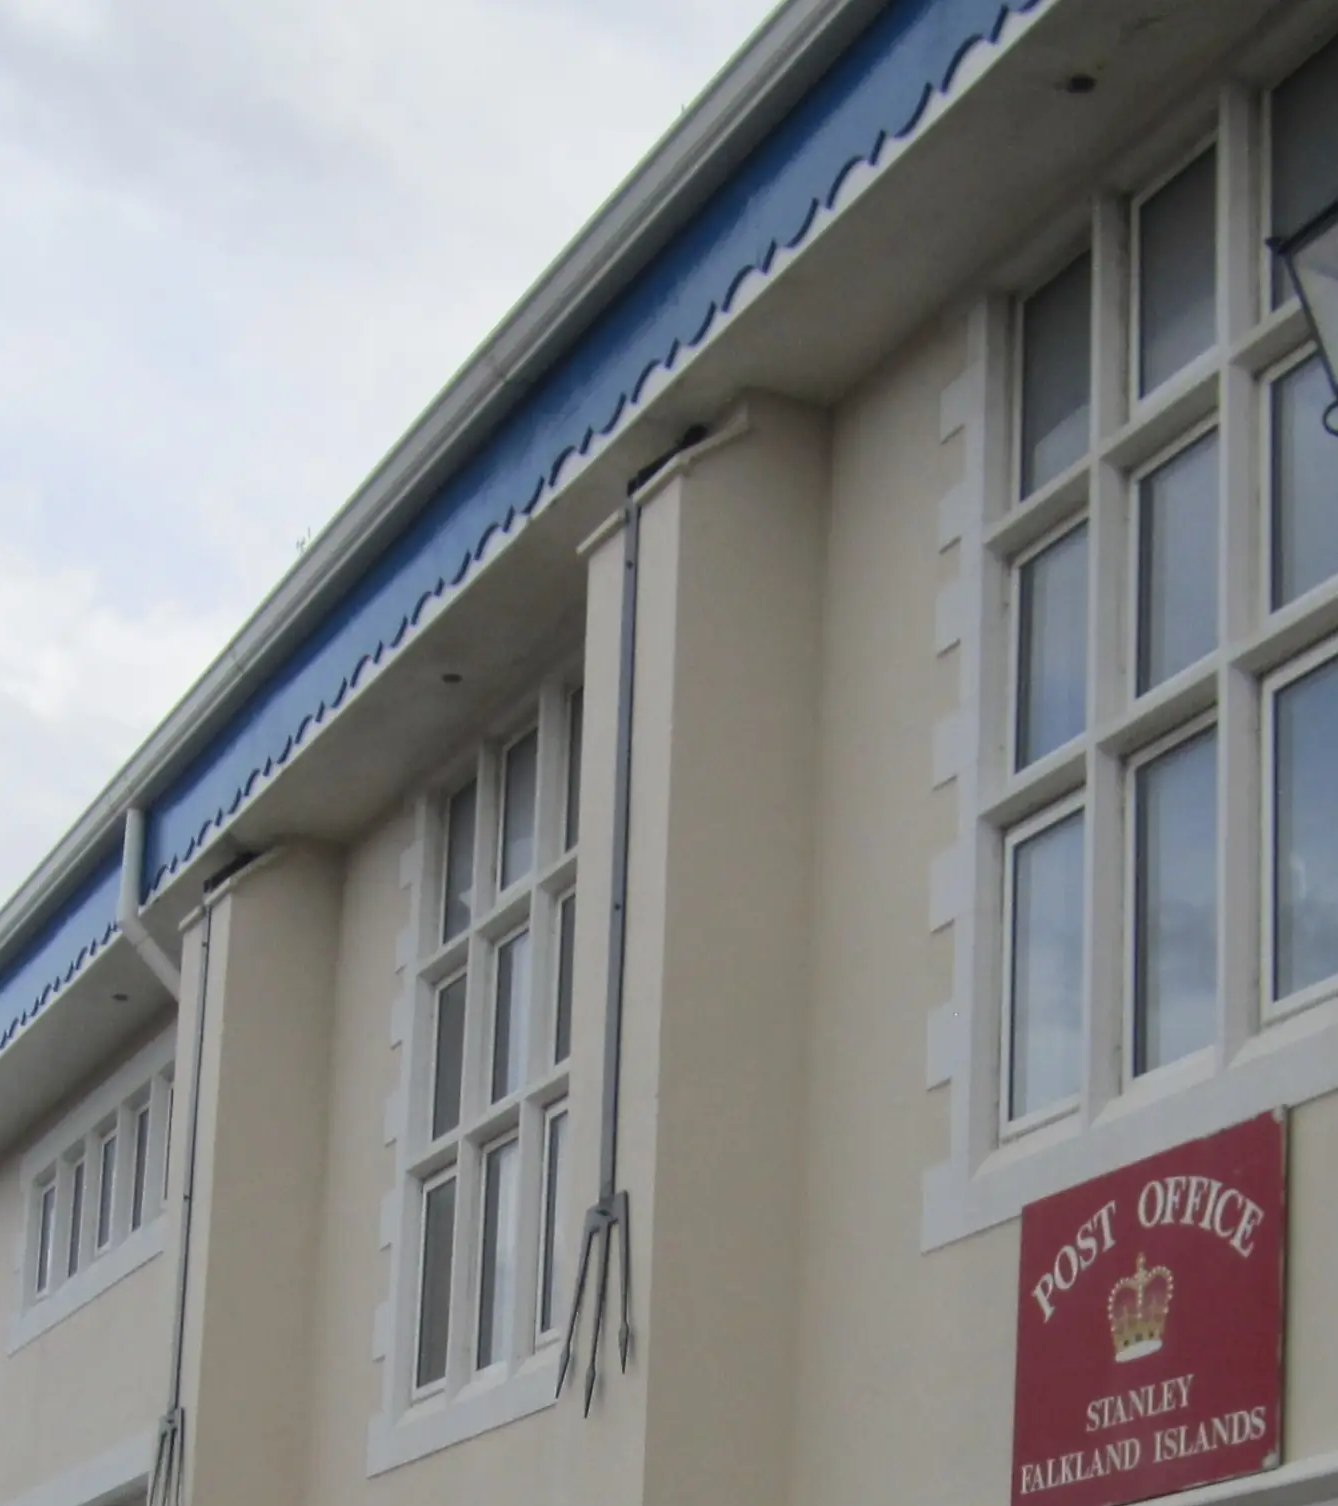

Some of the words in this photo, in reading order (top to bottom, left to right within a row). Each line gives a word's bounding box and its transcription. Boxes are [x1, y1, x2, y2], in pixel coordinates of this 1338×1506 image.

[1031, 1200, 1116, 1323] POST
[1137, 1175, 1263, 1258] OFFICE
[1085, 1374, 1194, 1432] STANLEY
[1019, 1438, 1140, 1495] FALKLAND
[1153, 1406, 1266, 1462] ISLANDS
